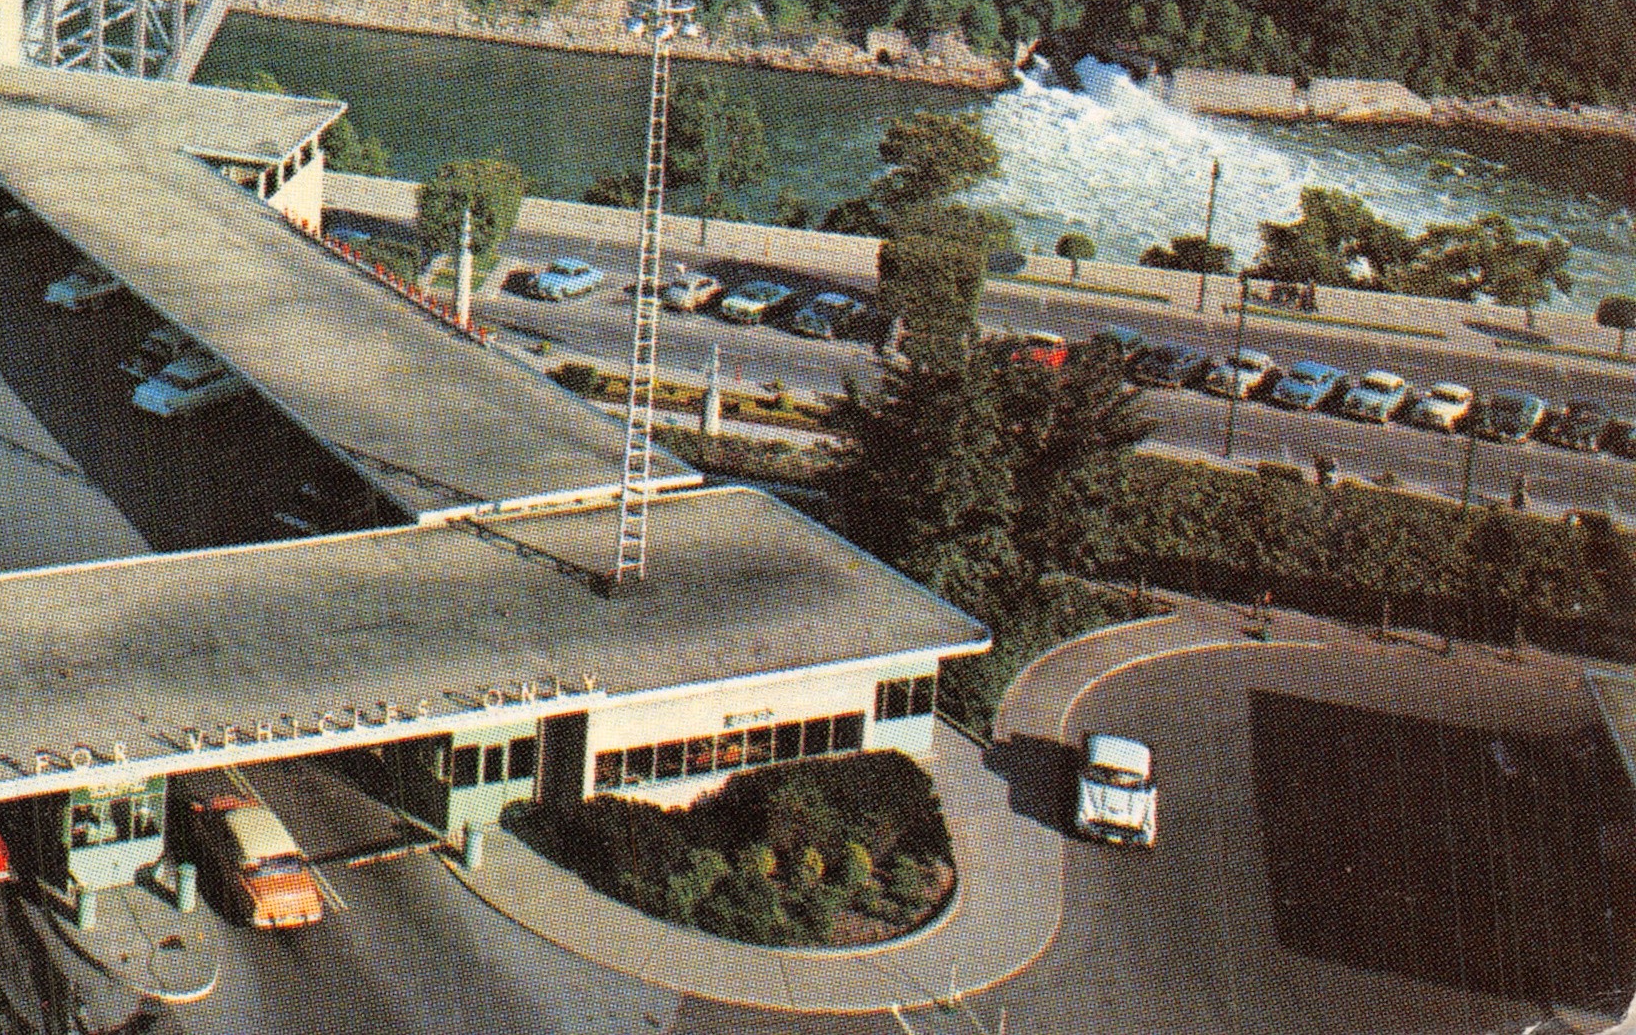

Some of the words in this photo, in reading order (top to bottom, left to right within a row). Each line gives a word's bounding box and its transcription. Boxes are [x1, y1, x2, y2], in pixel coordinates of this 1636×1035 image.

[35, 742, 128, 773] FOR
[188, 700, 428, 753] VEHICLES
[485, 673, 595, 707] ONLY
